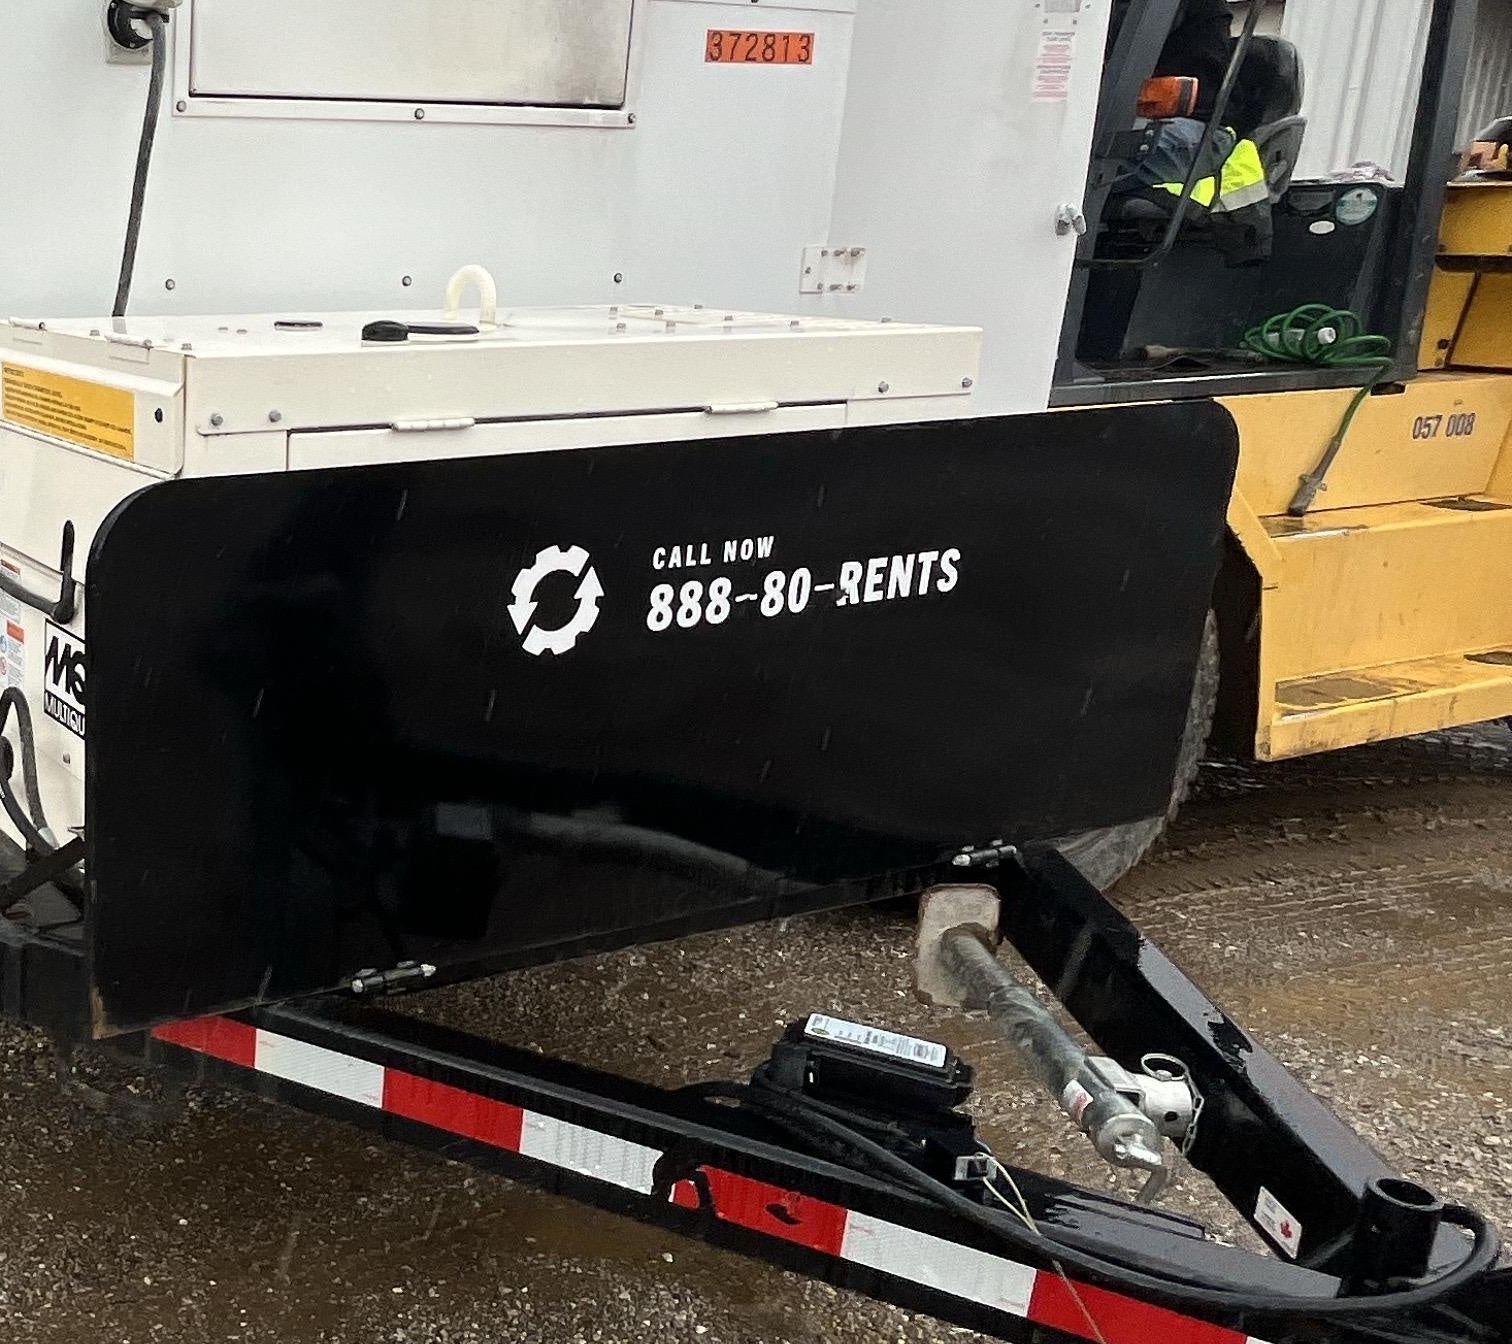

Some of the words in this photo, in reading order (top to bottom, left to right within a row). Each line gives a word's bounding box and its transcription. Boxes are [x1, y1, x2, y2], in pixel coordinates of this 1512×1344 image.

[710, 32, 811, 63] 372813
[1412, 415, 1443, 439] 057
[652, 543, 712, 570] CALL
[723, 536, 775, 563] NOW
[646, 548, 961, 632] 888-80-RENTS
[45, 692, 86, 736] MULTIQU
